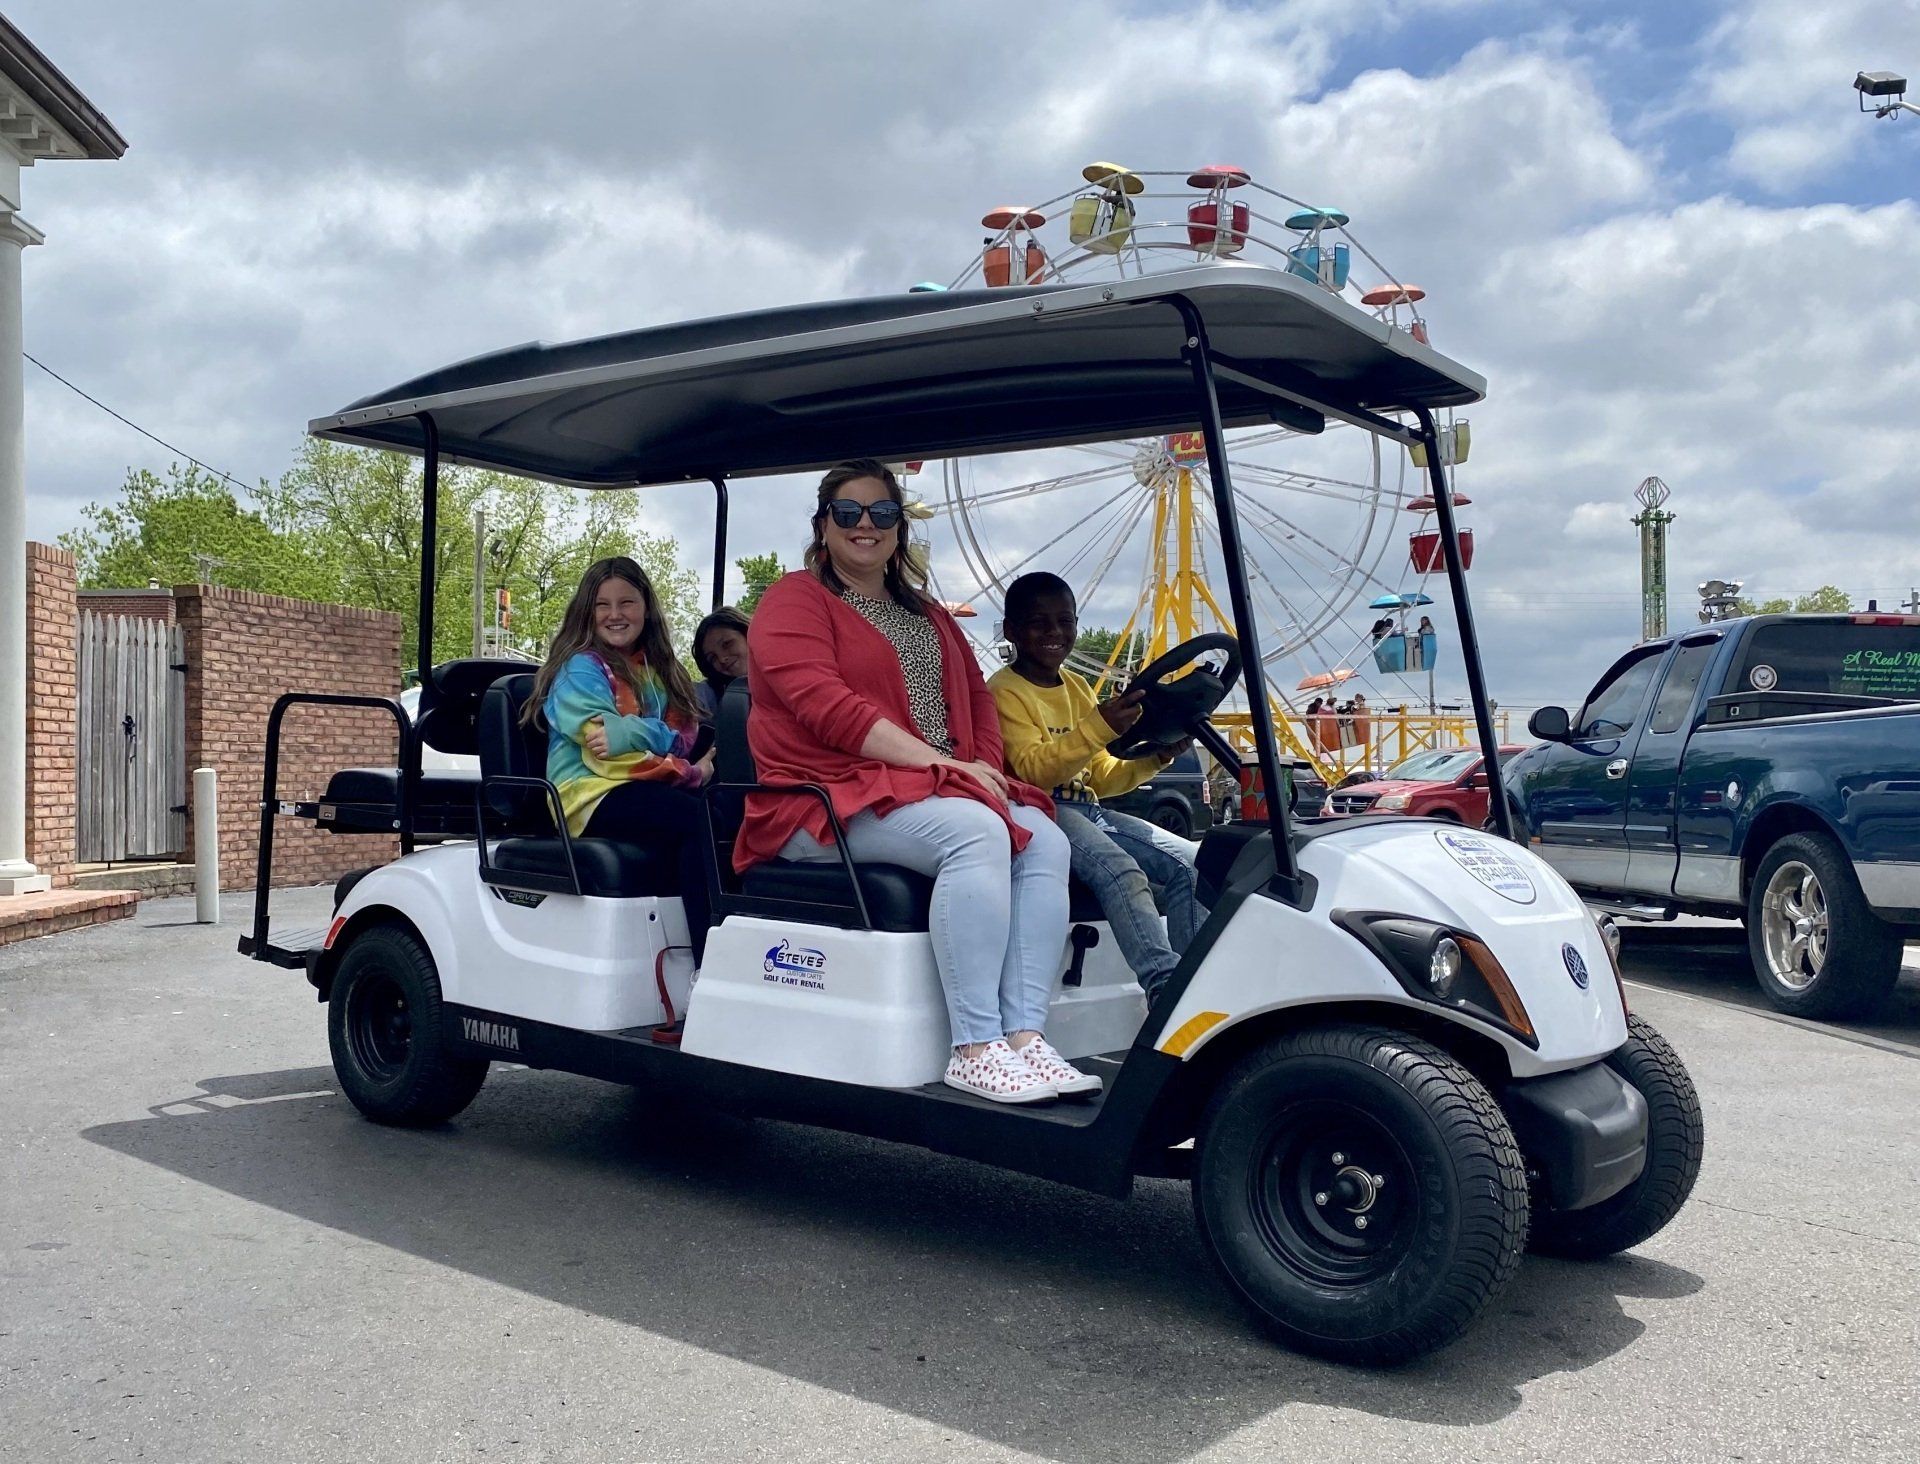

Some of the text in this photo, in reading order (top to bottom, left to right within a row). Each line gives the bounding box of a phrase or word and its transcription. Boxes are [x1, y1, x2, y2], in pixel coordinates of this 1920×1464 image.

[1168, 433, 1205, 451] PBJ
[1842, 650, 1862, 665] A
[1864, 650, 1902, 666] Real
[777, 952, 824, 968] STEVE'S
[763, 974, 825, 990] GOLF CART RENTAL
[462, 1017, 519, 1050] YAMAHA
